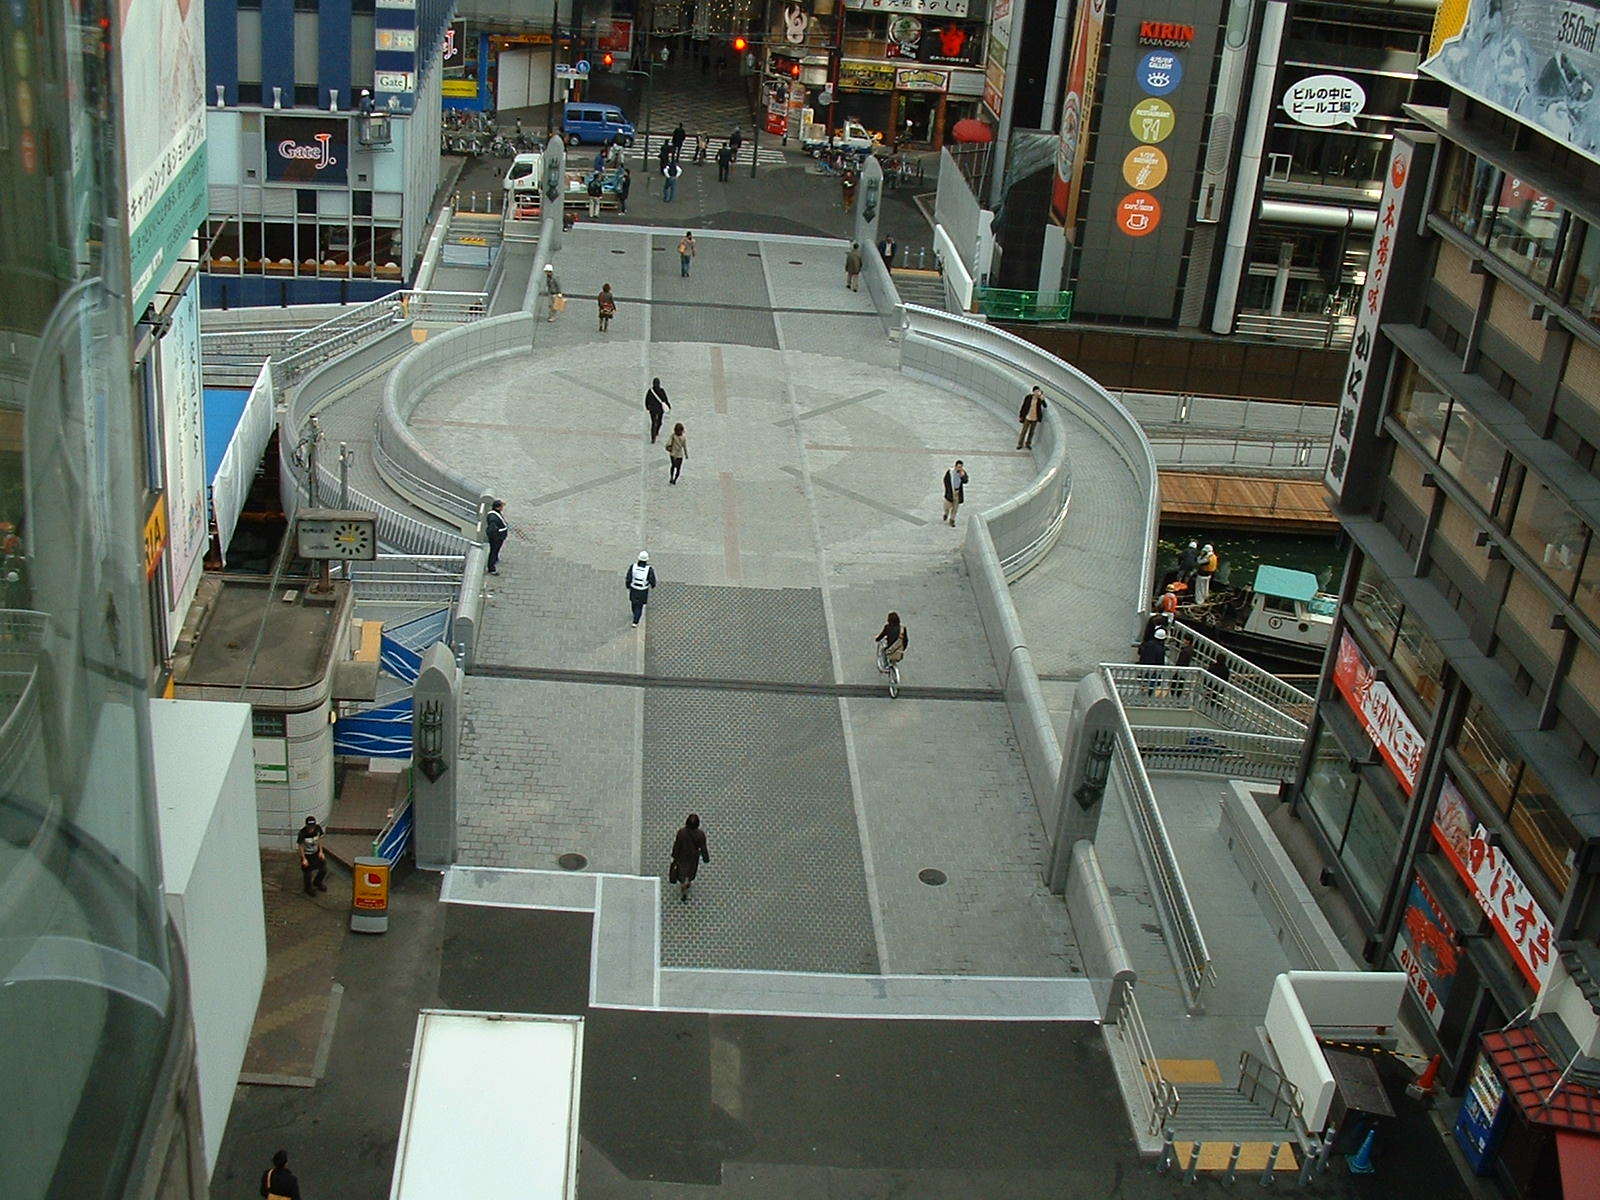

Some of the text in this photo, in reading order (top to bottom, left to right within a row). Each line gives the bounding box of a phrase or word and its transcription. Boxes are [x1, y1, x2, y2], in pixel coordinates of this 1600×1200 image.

[1140, 21, 1194, 40] KIRIN
[1557, 11, 1600, 53] 350ml
[1139, 37, 1191, 49] PLAZA OSAKA
[380, 76, 404, 88] Gate
[1293, 88, 1352, 99] ビルの中に
[278, 140, 321, 159] Gate
[1367, 198, 1395, 316] 本場の味
